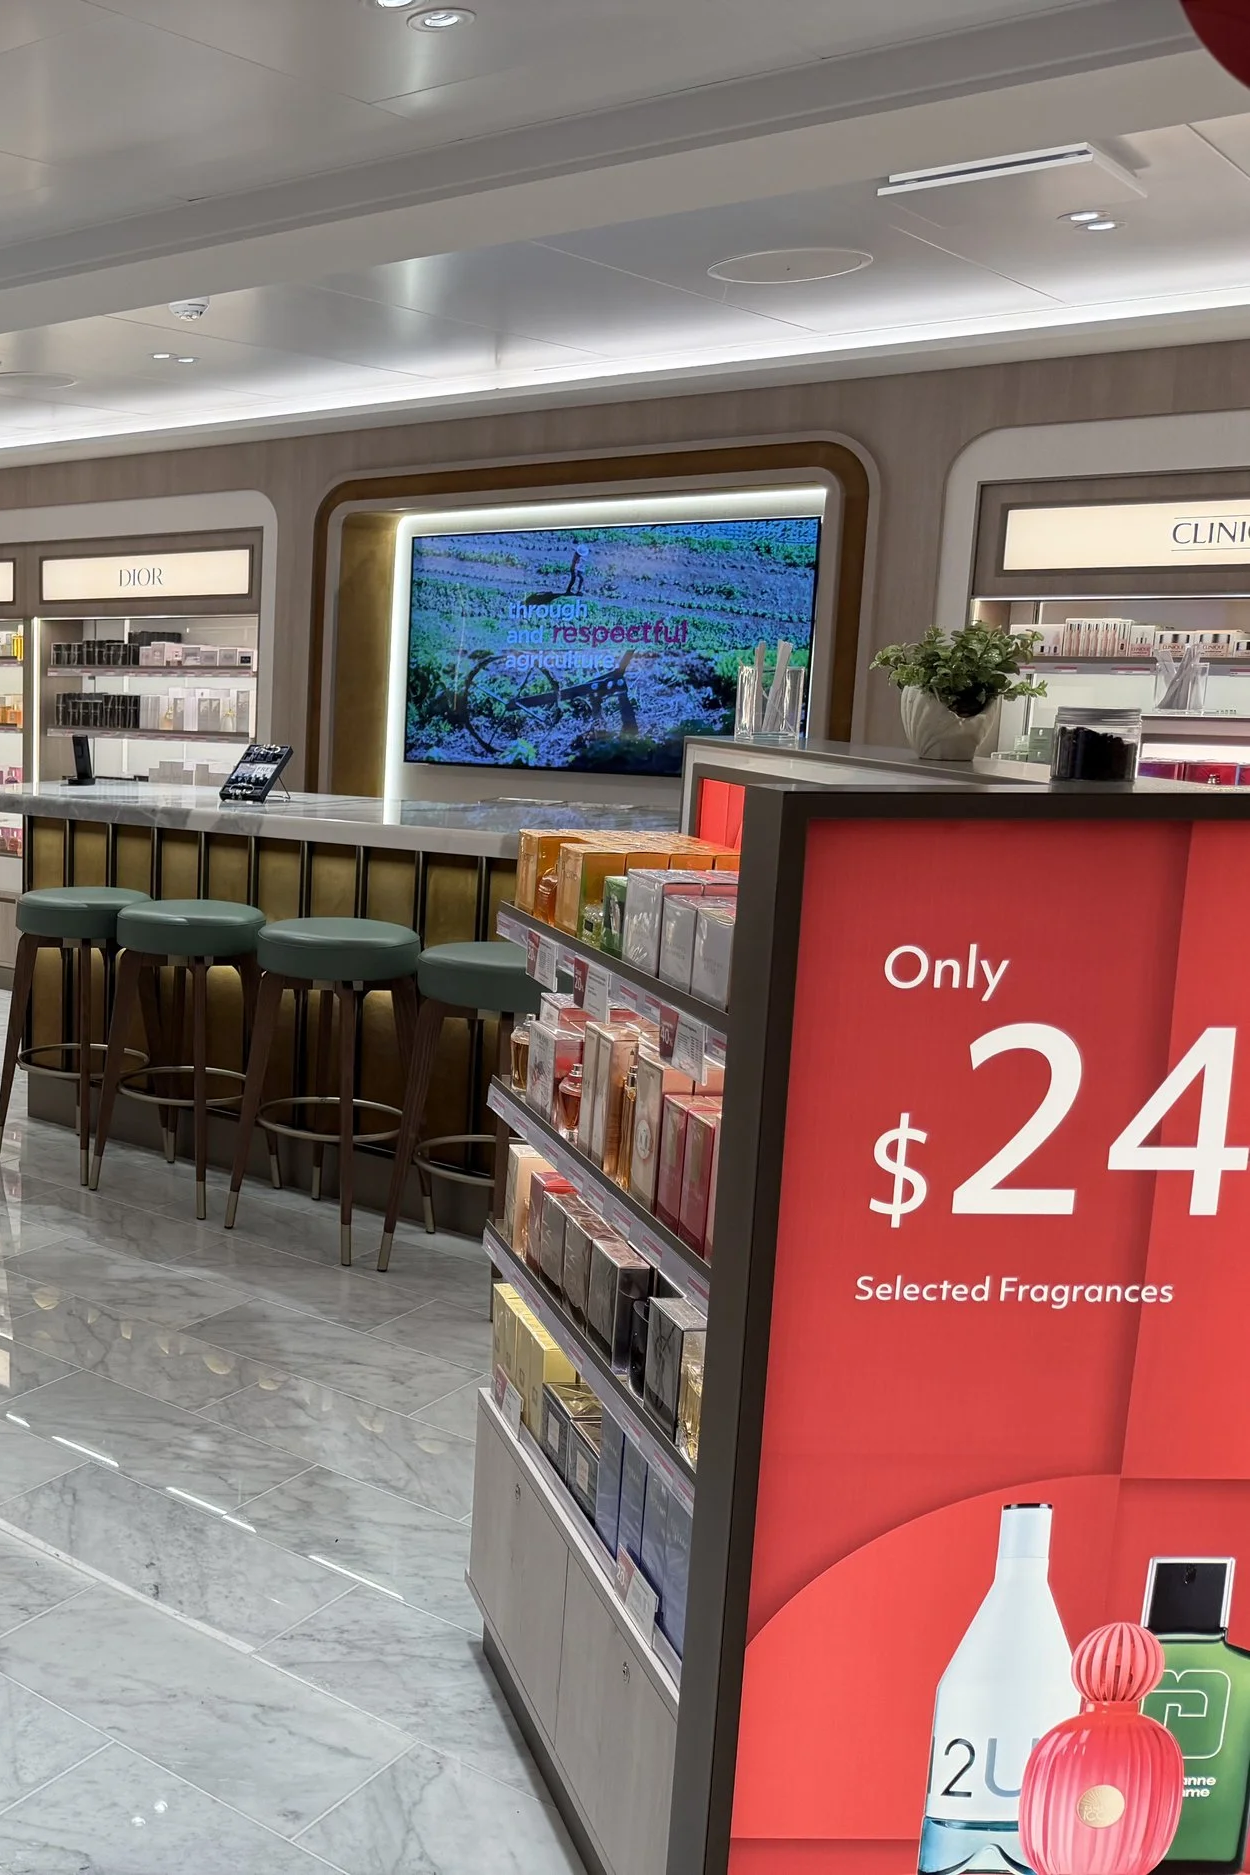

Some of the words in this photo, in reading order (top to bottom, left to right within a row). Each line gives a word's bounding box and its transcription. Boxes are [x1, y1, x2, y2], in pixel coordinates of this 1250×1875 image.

[1172, 521, 1250, 545] CLINI
[118, 568, 164, 587] DIOR
[508, 600, 588, 620] through
[506, 626, 543, 645] and
[551, 619, 689, 648] respectful
[883, 943, 1010, 1002] Only
[855, 1275, 990, 1302] Selected
[998, 1277, 1174, 1310] Fragrances
